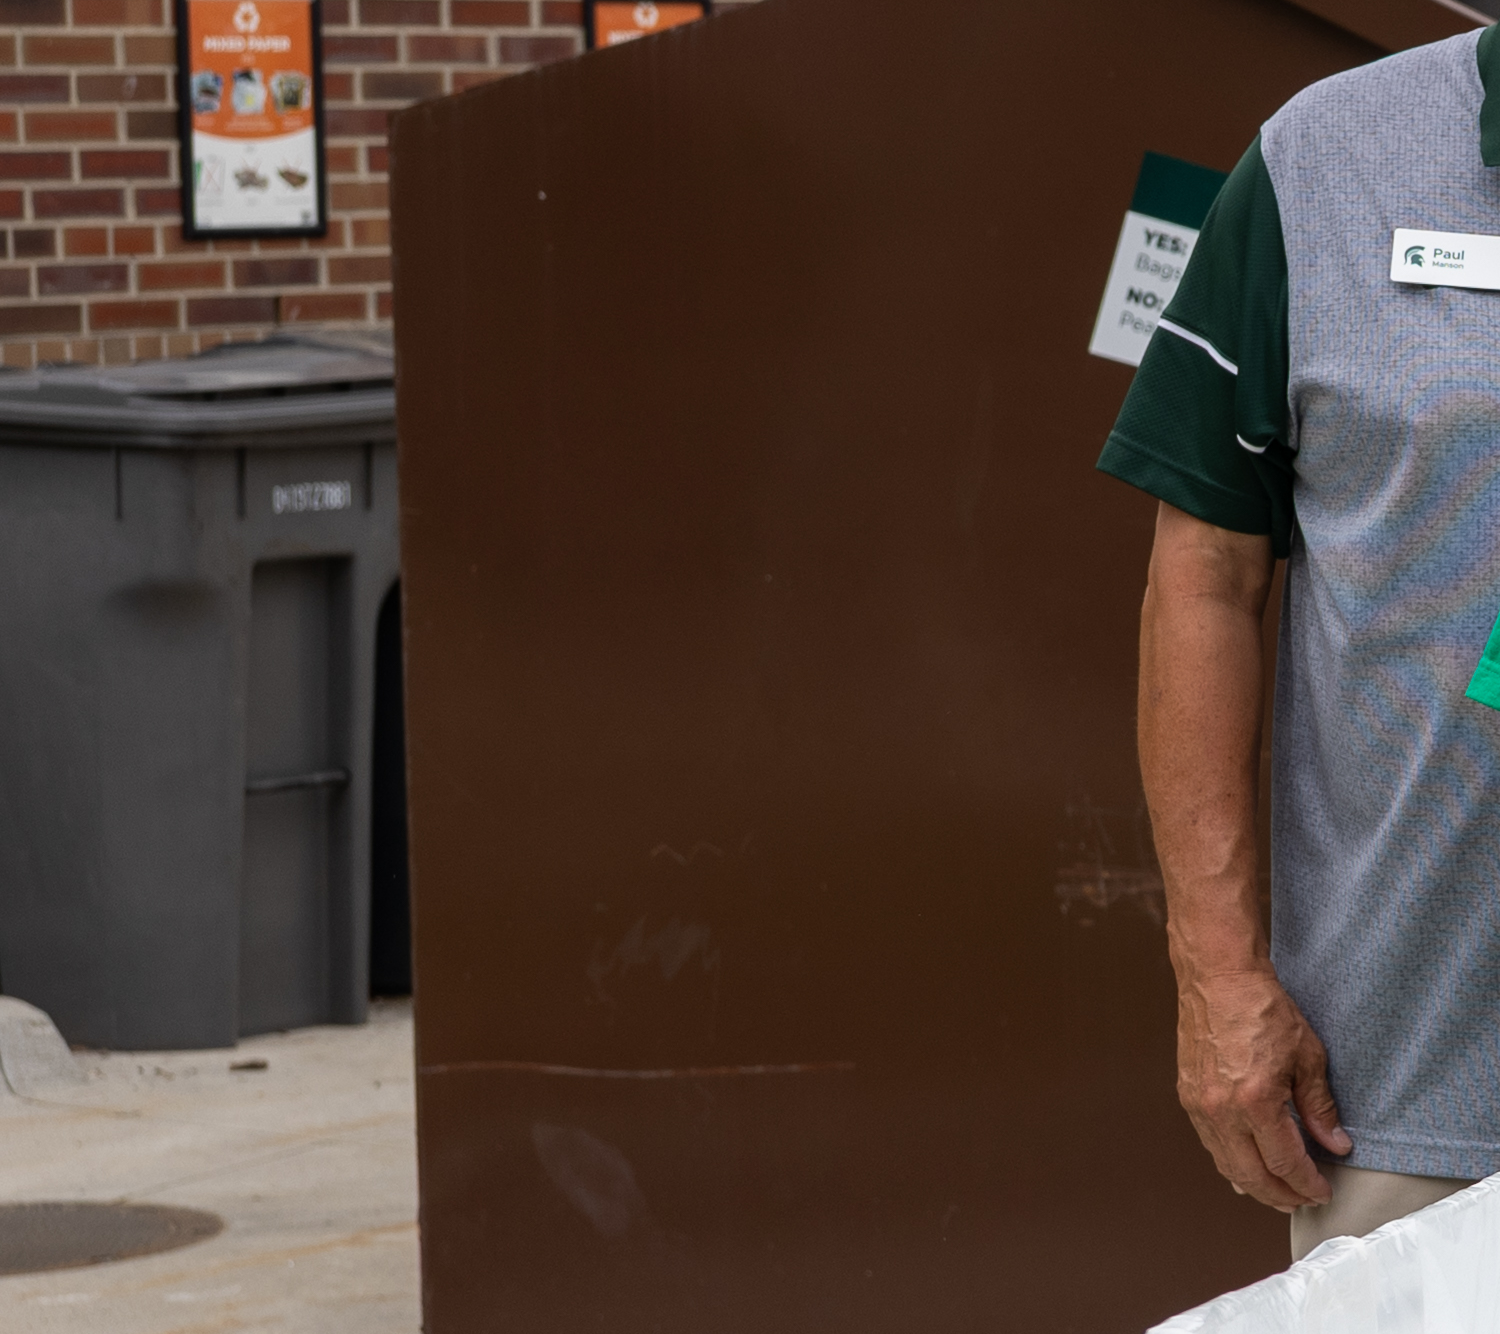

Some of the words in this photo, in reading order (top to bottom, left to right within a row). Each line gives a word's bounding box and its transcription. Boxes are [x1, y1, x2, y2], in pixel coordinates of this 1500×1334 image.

[248, 35, 291, 53] PAPER
[1143, 228, 1188, 256] YES:
[1433, 248, 1465, 260] Paul
[1126, 287, 1164, 311] NO:
